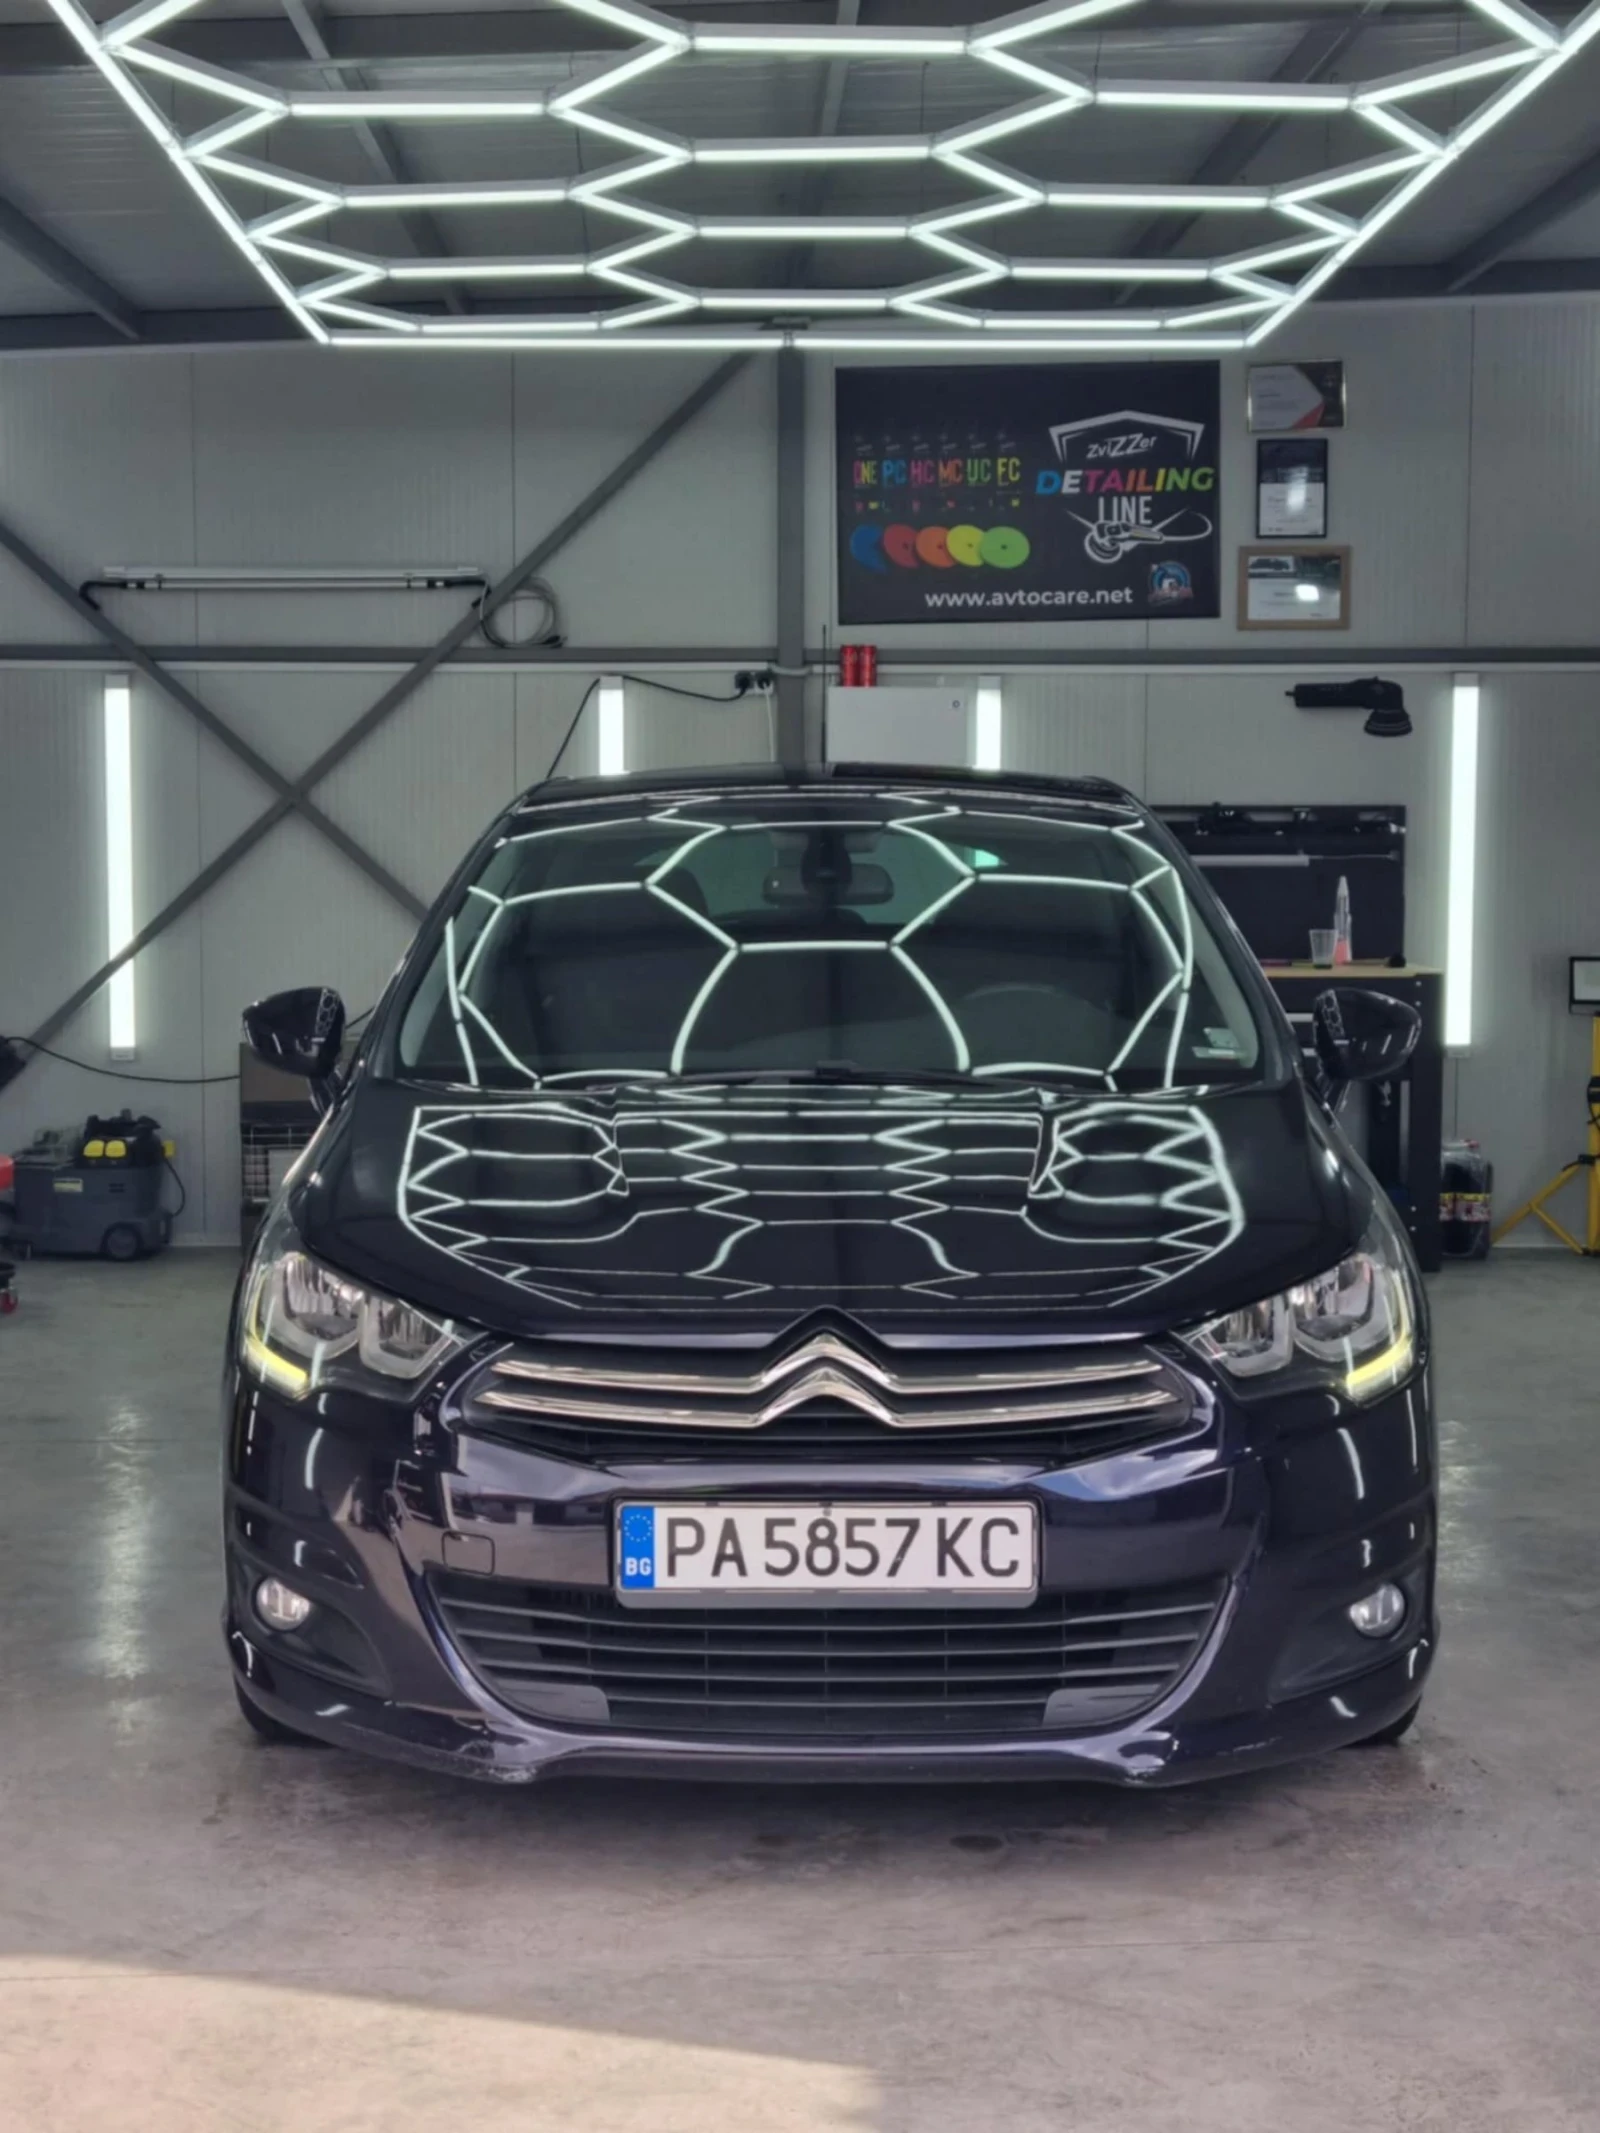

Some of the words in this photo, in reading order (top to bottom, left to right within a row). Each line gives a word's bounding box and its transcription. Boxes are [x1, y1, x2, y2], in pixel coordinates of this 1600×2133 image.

[882, 459, 907, 484] PC
[911, 458, 935, 484] HC
[939, 458, 963, 484] MC
[967, 458, 992, 482] UC
[1036, 467, 1215, 495] DETAILING
[1098, 496, 1153, 525] LINE
[925, 587, 1133, 608] www.avtocare.net
[764, 1517, 921, 1578] 5857
[625, 1557, 651, 1576] BG
